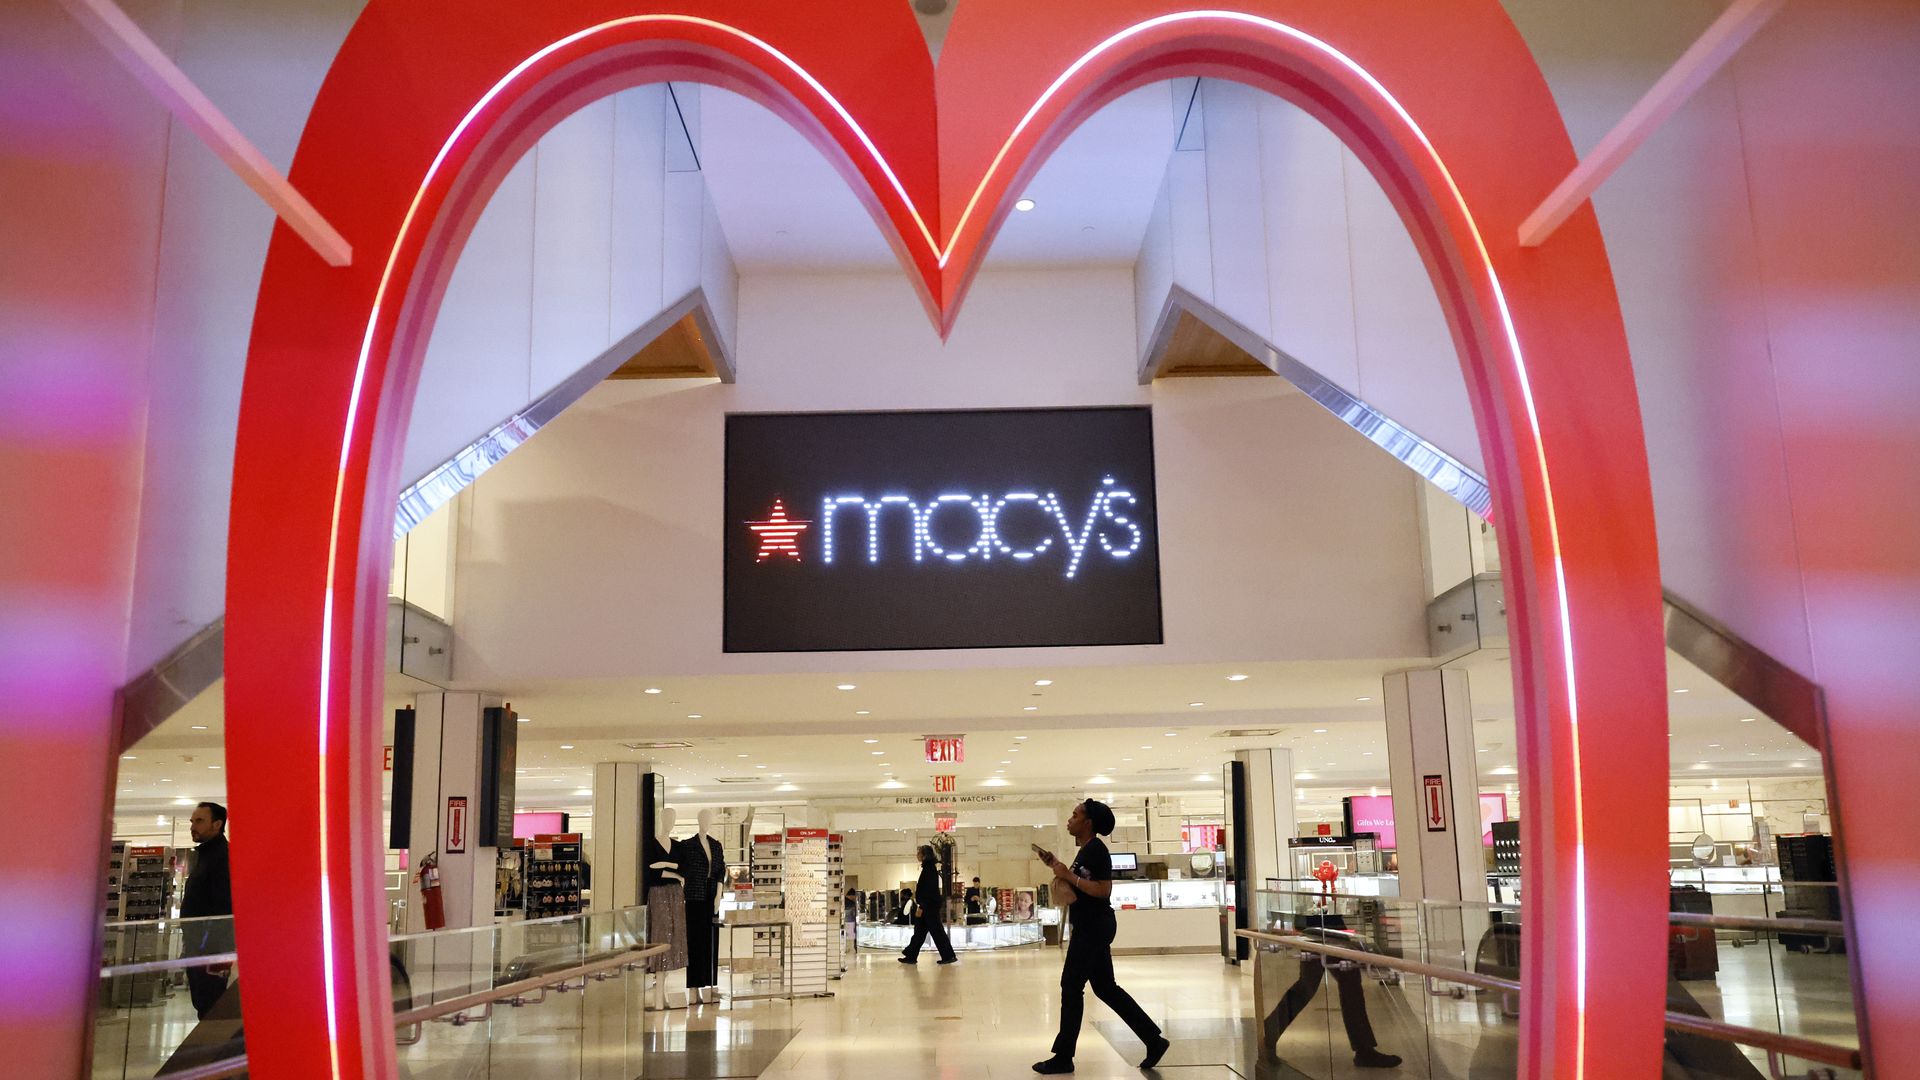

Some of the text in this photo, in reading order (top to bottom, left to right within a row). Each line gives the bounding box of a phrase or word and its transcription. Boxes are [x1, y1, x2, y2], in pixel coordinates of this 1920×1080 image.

[822, 474, 1142, 579] macy's
[930, 739, 959, 761] EXIT
[935, 775, 956, 792] EXIT
[449, 799, 466, 807] FIRE
[1357, 818, 1373, 826] Gifts
